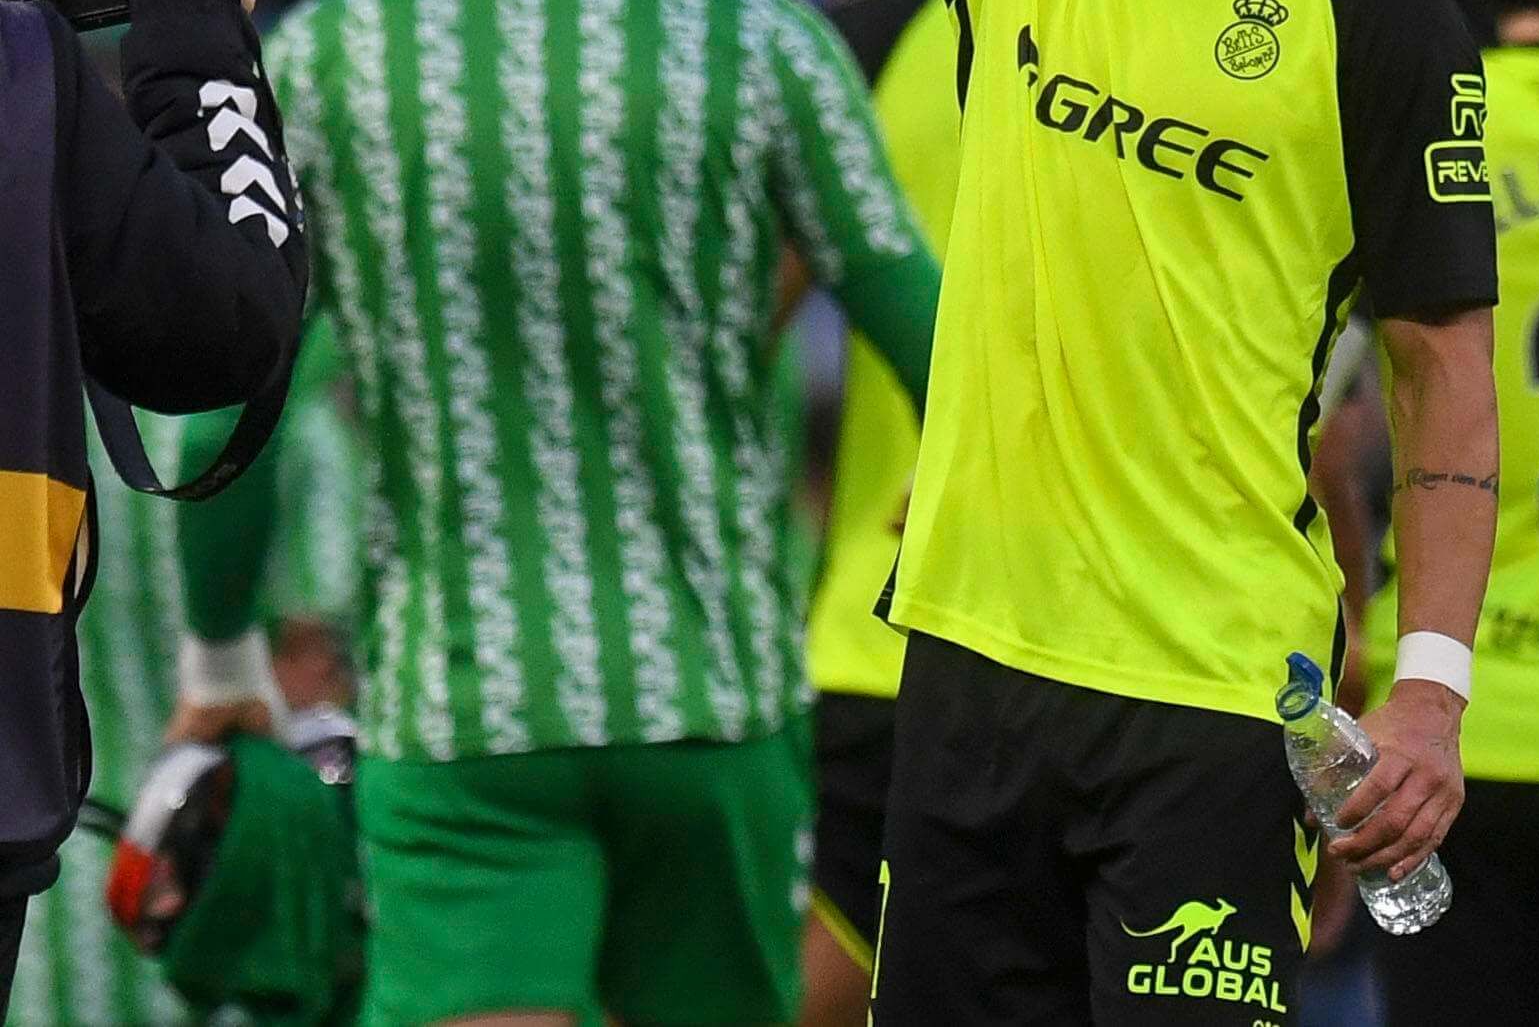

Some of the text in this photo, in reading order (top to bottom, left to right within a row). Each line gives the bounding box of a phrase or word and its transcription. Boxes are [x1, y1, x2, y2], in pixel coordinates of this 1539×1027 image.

[1035, 74, 1270, 203] GREE
[1187, 937, 1272, 976] AUS
[1127, 964, 1287, 1014] GLOBAL
